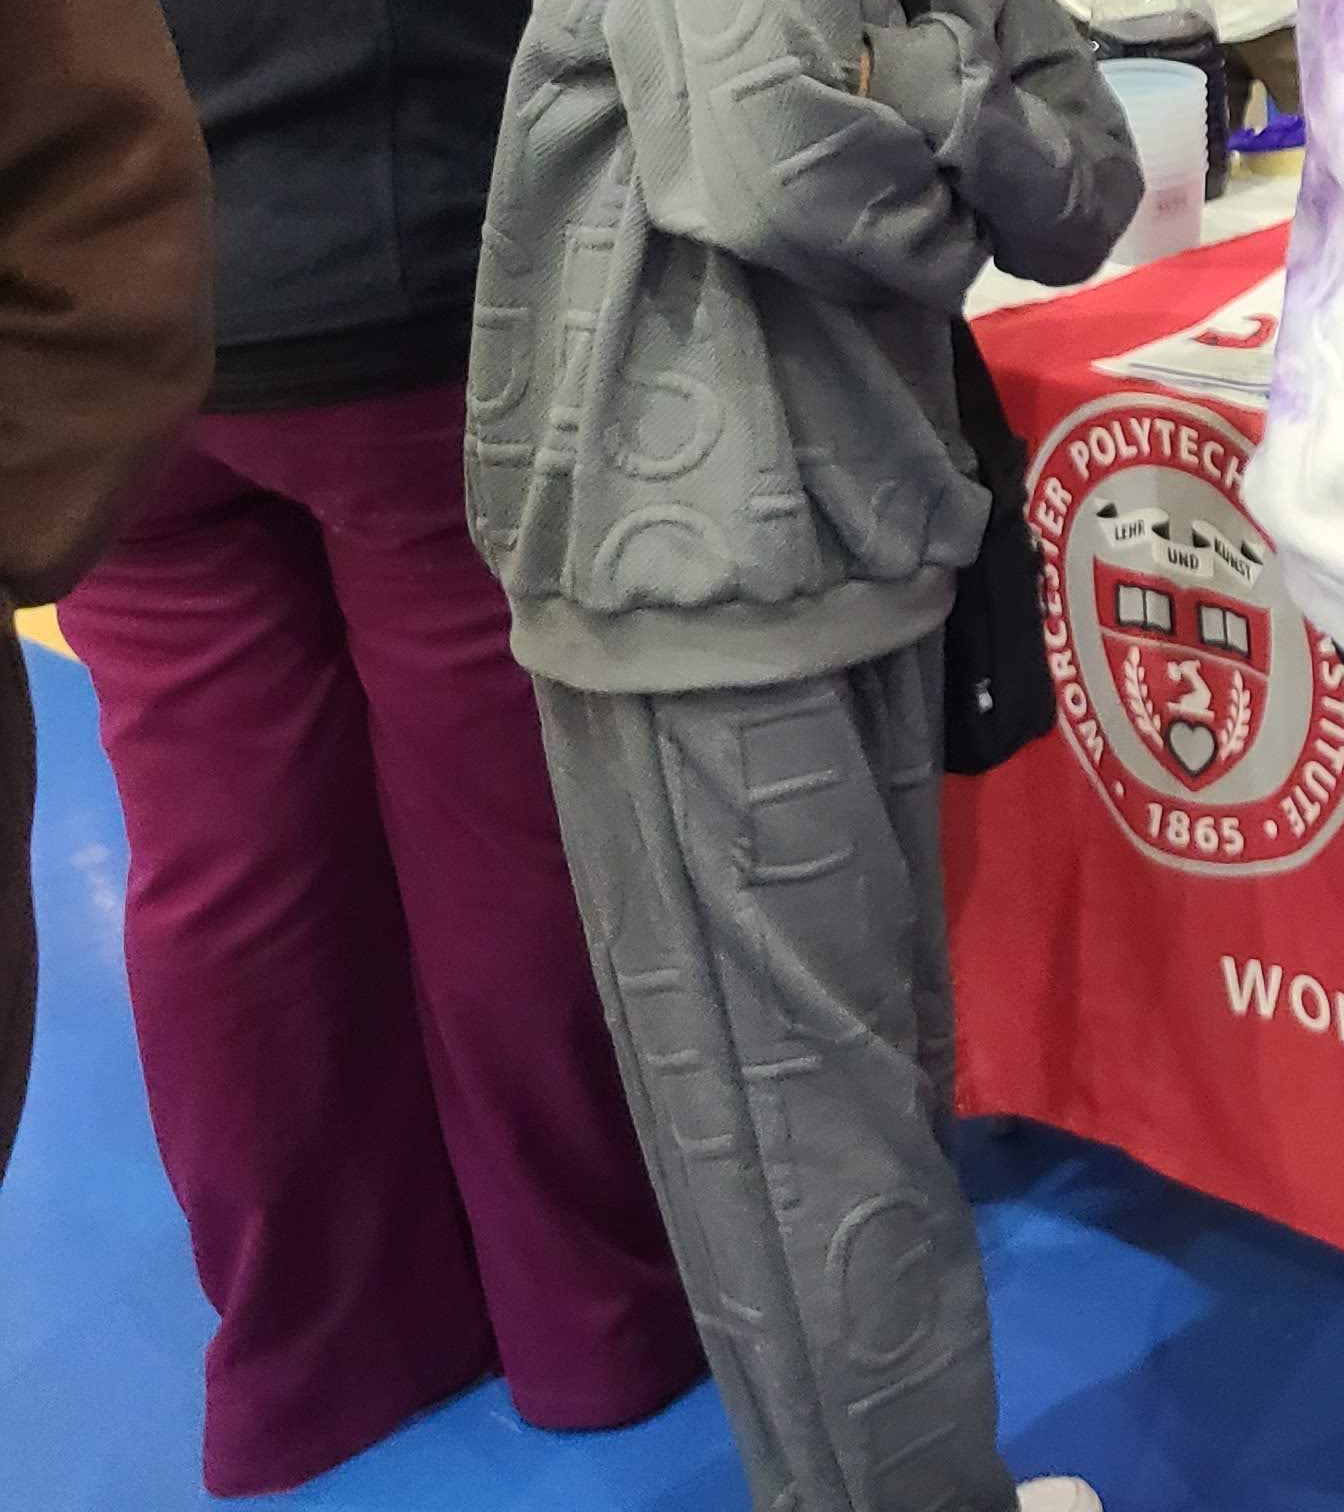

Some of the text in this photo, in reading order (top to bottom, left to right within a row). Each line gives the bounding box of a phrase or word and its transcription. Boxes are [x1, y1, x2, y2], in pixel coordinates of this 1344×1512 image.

[1167, 546, 1199, 570] UND
[1214, 536, 1252, 582] KUNST
[1146, 802, 1245, 856] 1865
